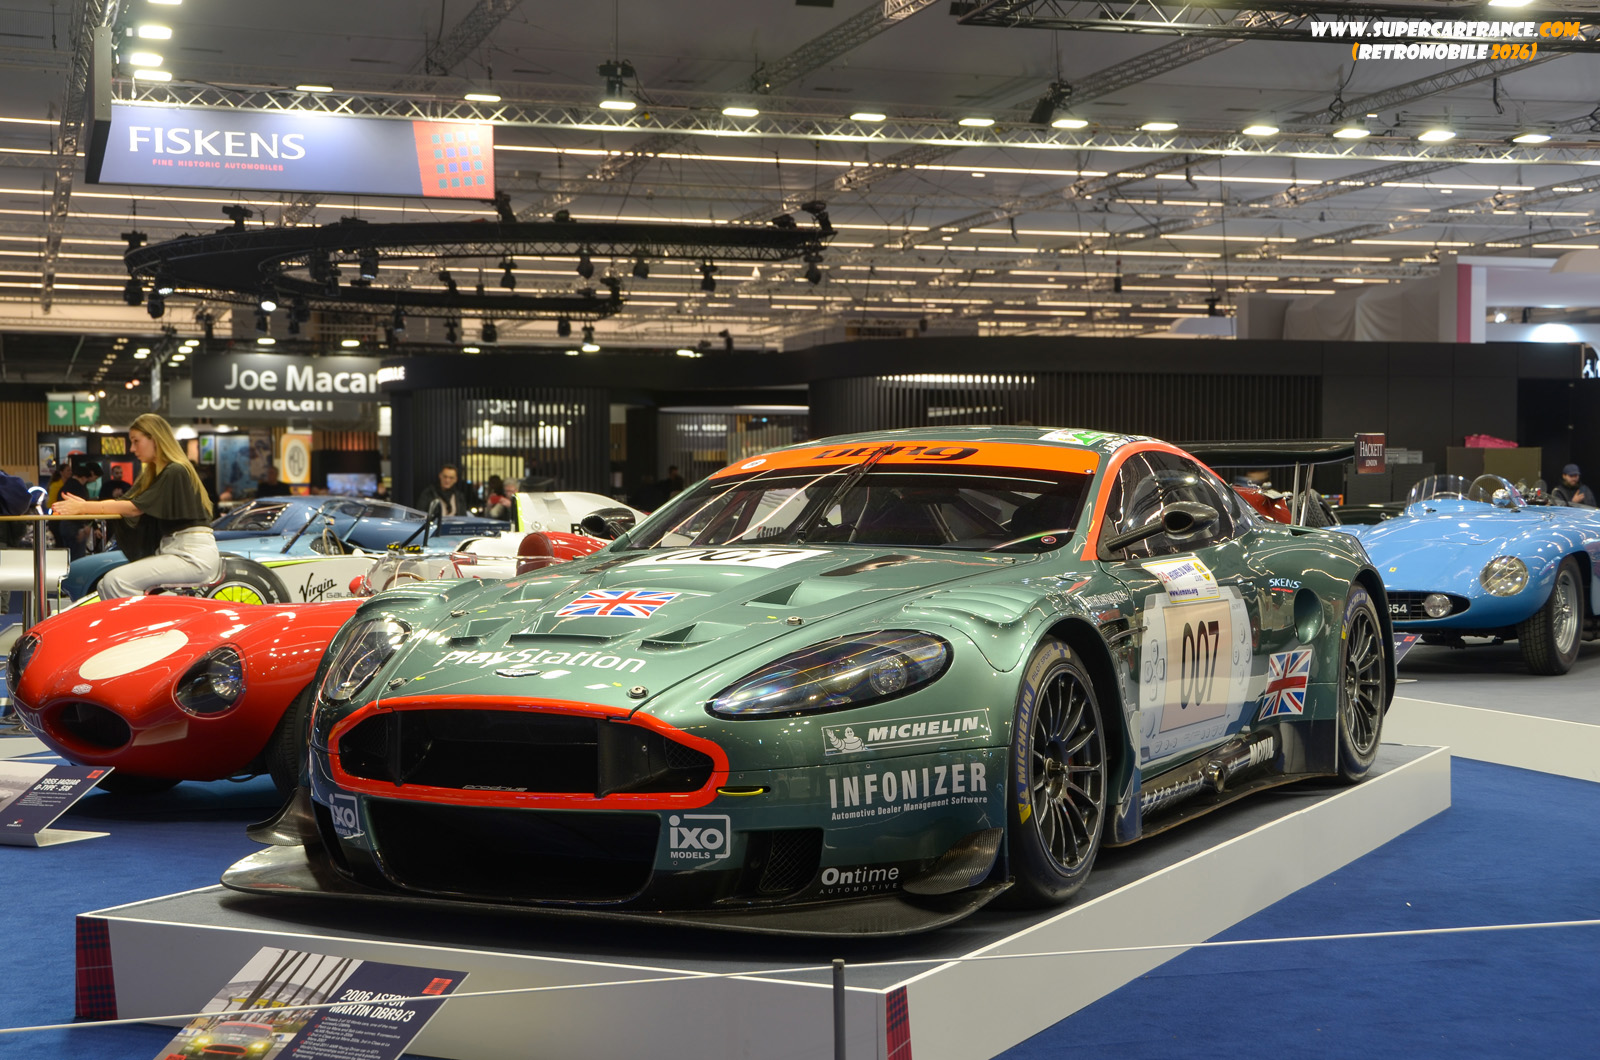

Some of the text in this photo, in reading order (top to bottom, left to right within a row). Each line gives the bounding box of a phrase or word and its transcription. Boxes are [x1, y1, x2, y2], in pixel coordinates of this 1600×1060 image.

[129, 126, 306, 160] FISKENS
[152, 158, 284, 172] FINE HISTORIC AUTOMOBILES
[224, 363, 278, 391] Joe
[286, 365, 379, 394] Macar
[1365, 459, 1378, 467] LONDON
[655, 549, 805, 562] 007
[299, 572, 337, 602] Virgin
[433, 648, 647, 674] PlayStation
[1180, 620, 1219, 710] 007
[867, 716, 979, 742] MICHELIN
[1017, 689, 1033, 785] MICHELIN
[829, 762, 987, 809] INFONIZER
[831, 795, 988, 821] Automotive Dealer Management Software
[669, 814, 724, 850] ixo
[670, 850, 711, 860] MODELS
[819, 882, 898, 895] AUTOMOTIVE
[821, 866, 899, 887] Ontime
[340, 988, 374, 1003] 2006
[369, 1006, 416, 1023] DBR9/3
